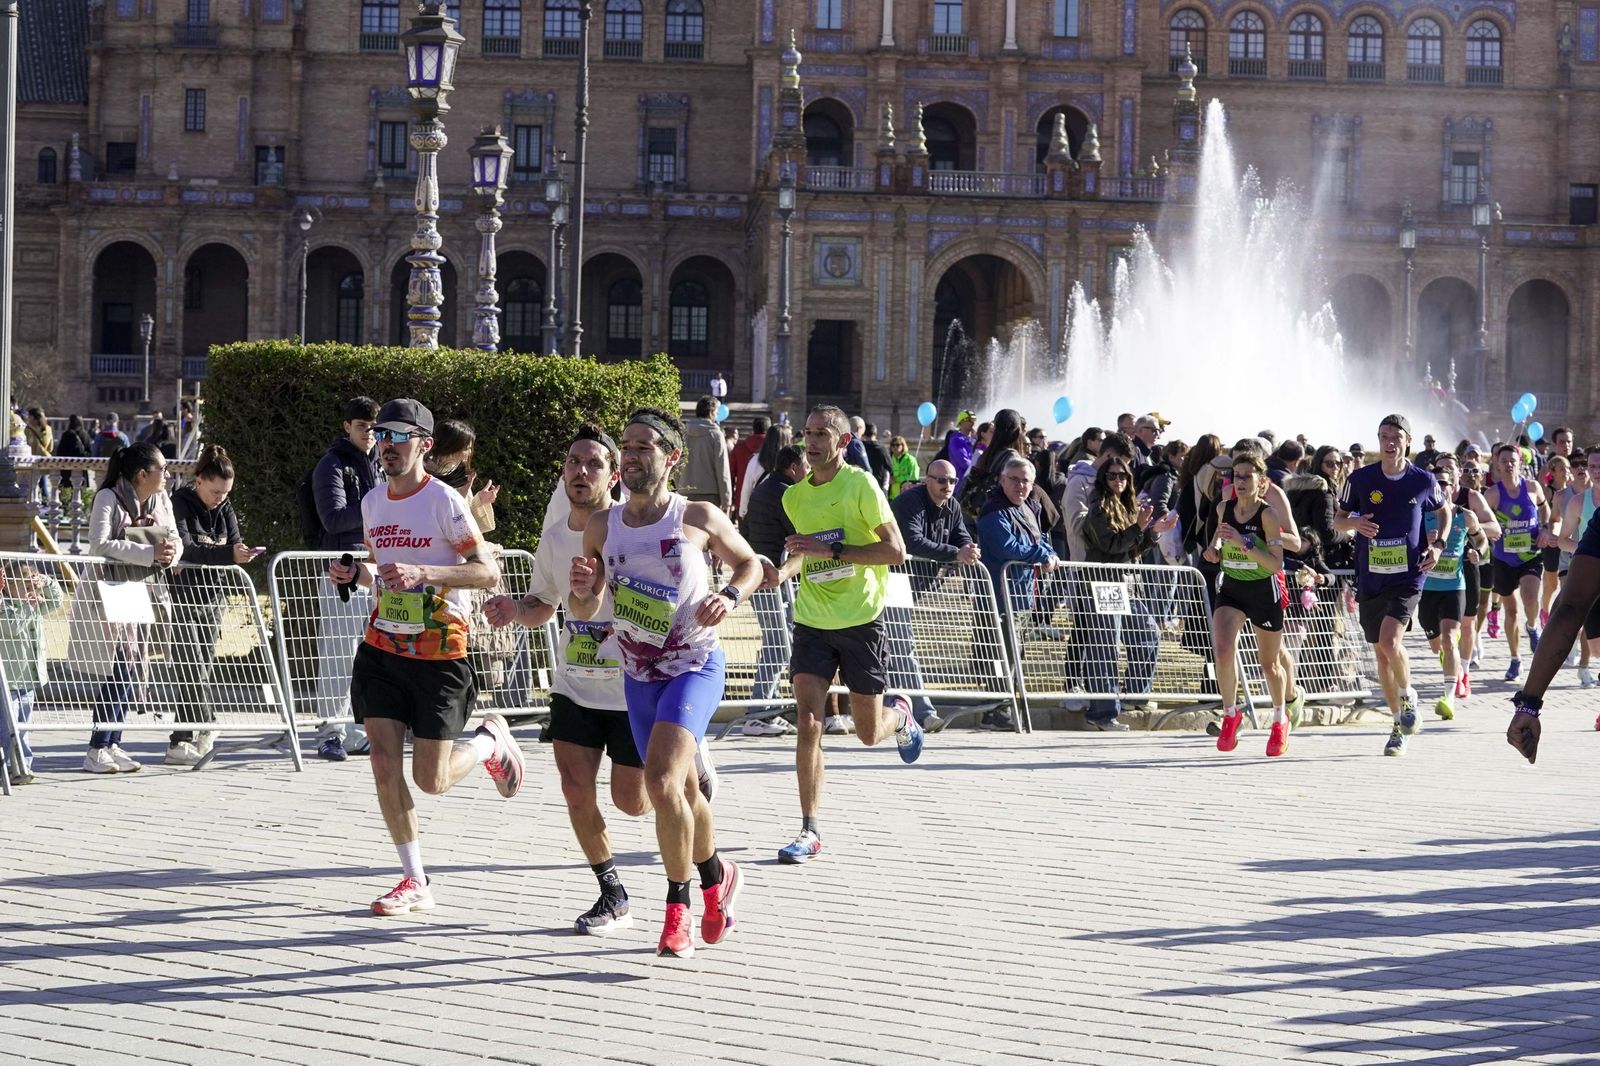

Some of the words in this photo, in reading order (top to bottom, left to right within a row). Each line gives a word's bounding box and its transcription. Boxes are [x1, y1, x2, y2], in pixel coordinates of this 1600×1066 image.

[368, 524, 399, 538] OURSE
[375, 537, 432, 548] COTEAUX
[806, 559, 852, 573] ALEXAND
[1372, 556, 1404, 565] TOMILLO
[633, 581, 670, 598] ZURICH
[631, 597, 649, 610] 1969
[386, 608, 409, 621] KRIKO
[614, 603, 670, 633] OMINGOS
